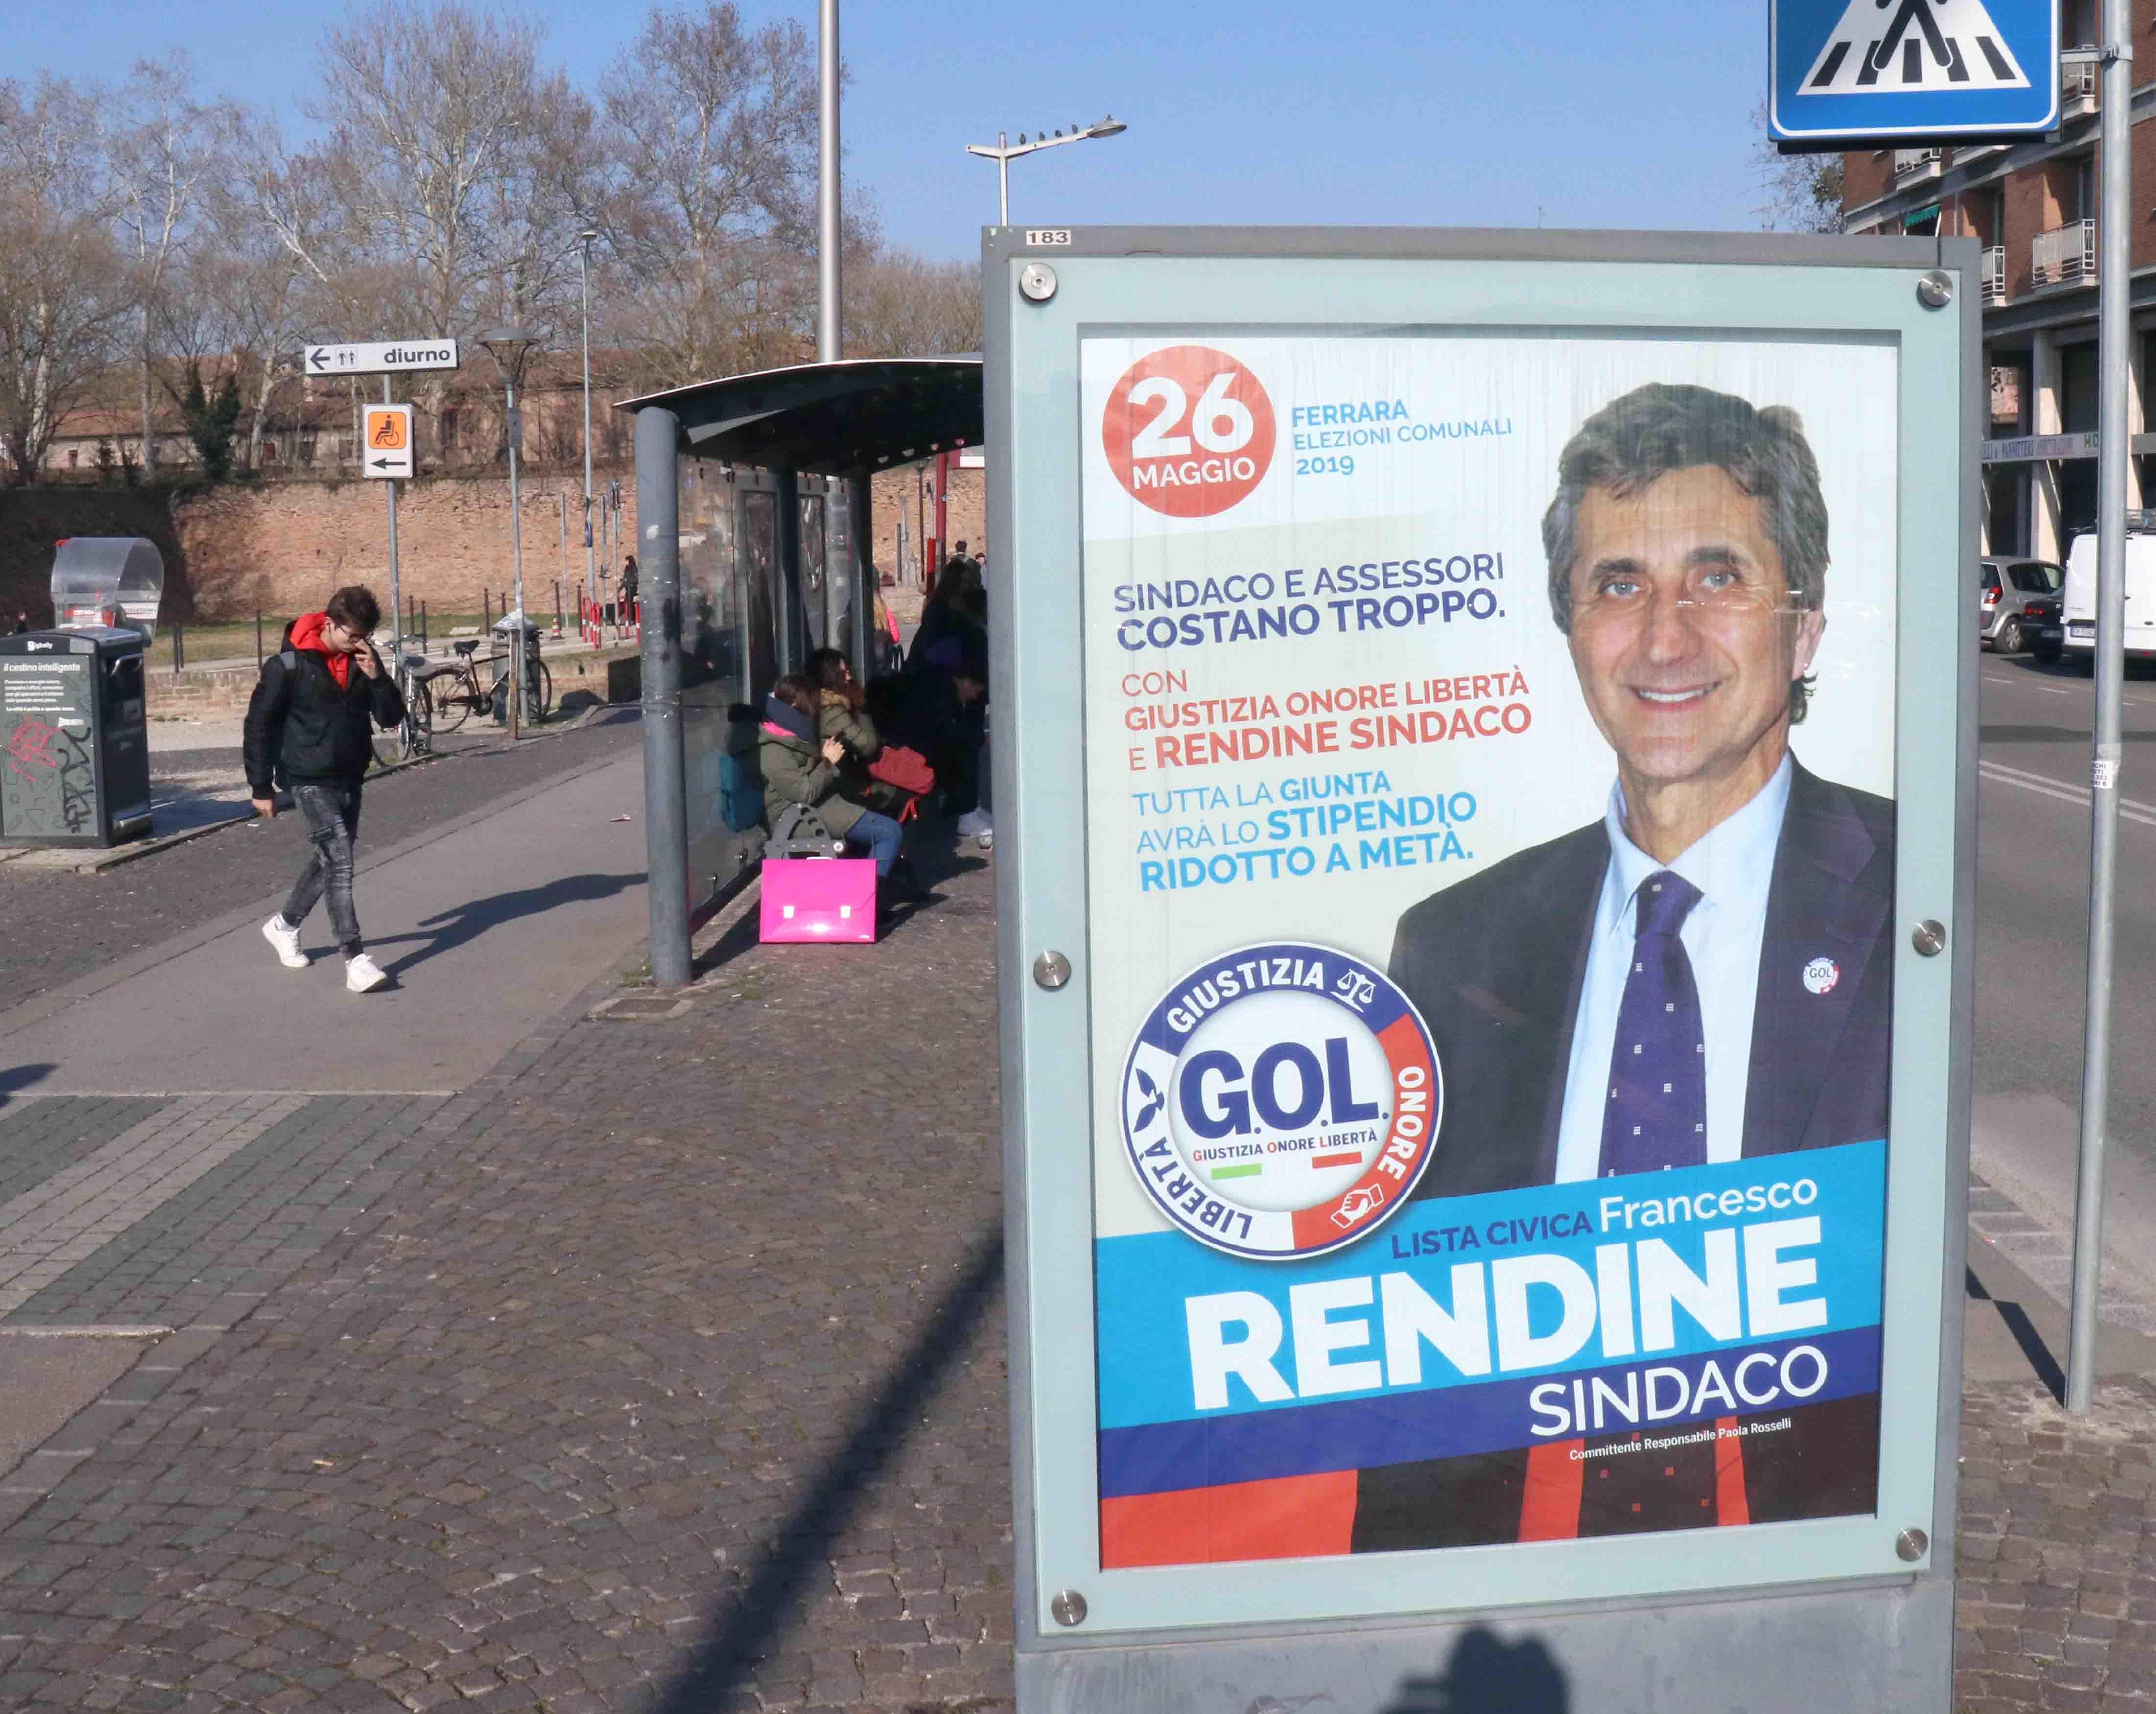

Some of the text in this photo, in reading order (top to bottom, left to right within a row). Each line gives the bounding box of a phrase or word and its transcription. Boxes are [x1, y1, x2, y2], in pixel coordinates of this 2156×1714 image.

[1028, 231, 1068, 244] 183
[384, 348, 450, 363] diurno
[1127, 372, 1254, 459] 26
[1292, 399, 1410, 427] FERRARA
[1292, 418, 1512, 451] ELEZIONI COMUNALI
[1133, 457, 1256, 490] MAGGIO
[1296, 455, 1355, 476] 2019
[1114, 552, 1504, 613] SINDACO E ASSESSORI
[1118, 588, 1506, 651] COSTANO TROPPO.
[1122, 669, 1188, 697] CON
[1125, 665, 1530, 731] GIUSTIZIA ONORE LIBERTÀ
[1129, 704, 1532, 771] E RENDINE SINDACO
[1132, 770, 1392, 815] TUTTA LA GIUNTA
[1136, 791, 1476, 854] AVRÀ LO STIPENDIO
[1140, 822, 1473, 892] RIDOTTO A METÀ.
[1167, 958, 1324, 1033] GIUSTIZIA
[1179, 1037, 1389, 1139] G.O.L.
[1192, 1127, 1378, 1162] GIUSTIZIA ONORE LIBERTÀ
[1377, 1066, 1426, 1180] ONORE
[1138, 1137, 1253, 1239] LIBERTÀ
[1600, 1179, 1818, 1232] Francesco
[1391, 1211, 1594, 1259] LISTA CIVICA
[1185, 1216, 1827, 1410] RENDINE
[1529, 1345, 1828, 1436] SINDACO
[1570, 1417, 1792, 1461] Committente Responsabile Paola Rosselli
